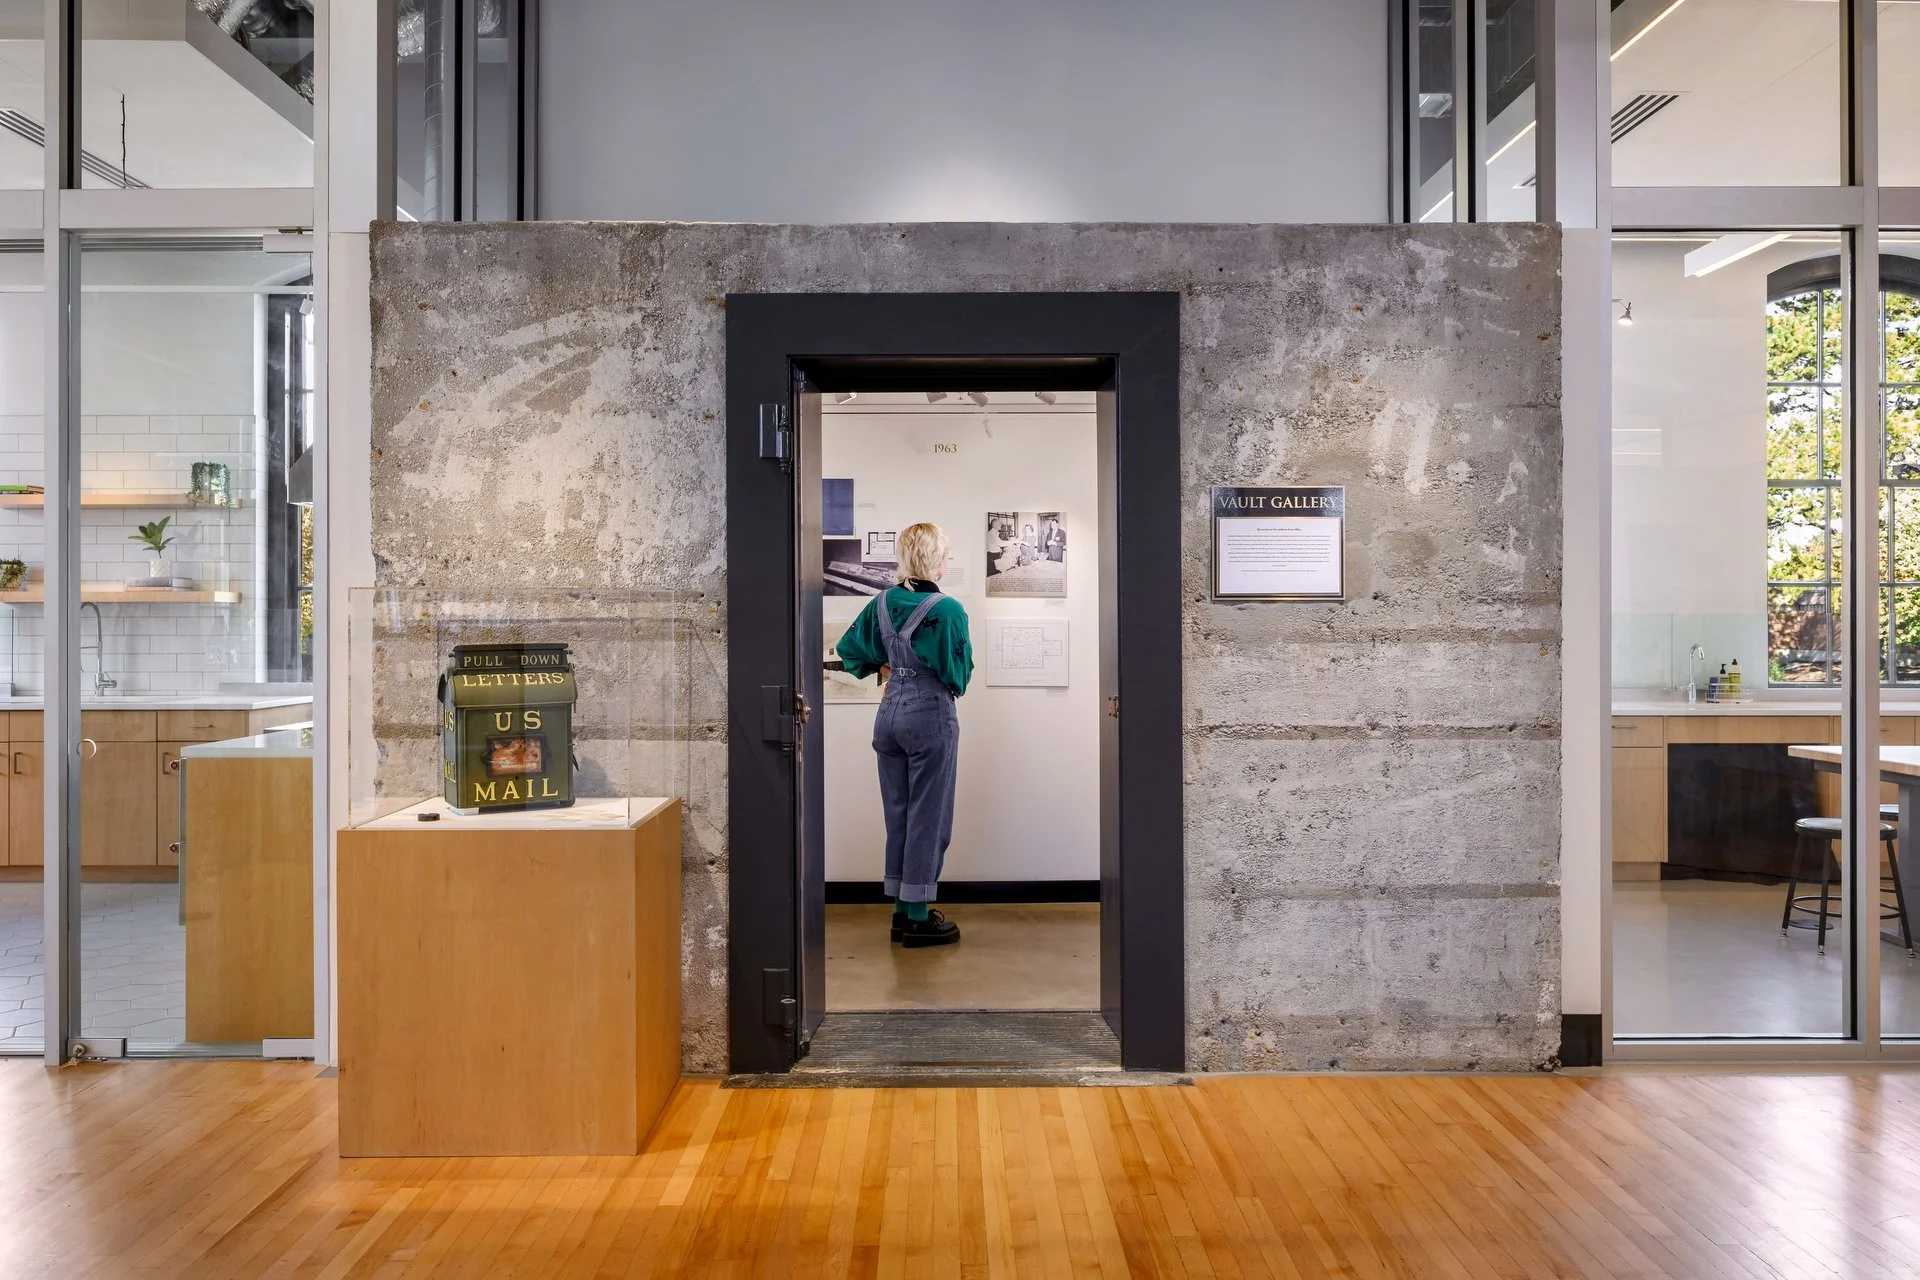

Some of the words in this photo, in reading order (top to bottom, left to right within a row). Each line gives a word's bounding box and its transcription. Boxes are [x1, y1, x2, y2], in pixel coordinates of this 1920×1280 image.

[934, 443, 957, 454] 1963
[1219, 496, 1267, 509] VAULT
[1270, 496, 1339, 509] GALLERY
[463, 655, 503, 667] PULL
[520, 654, 560, 667] DOWN
[462, 672, 565, 687] LETTERS
[474, 777, 559, 803] MAIL
